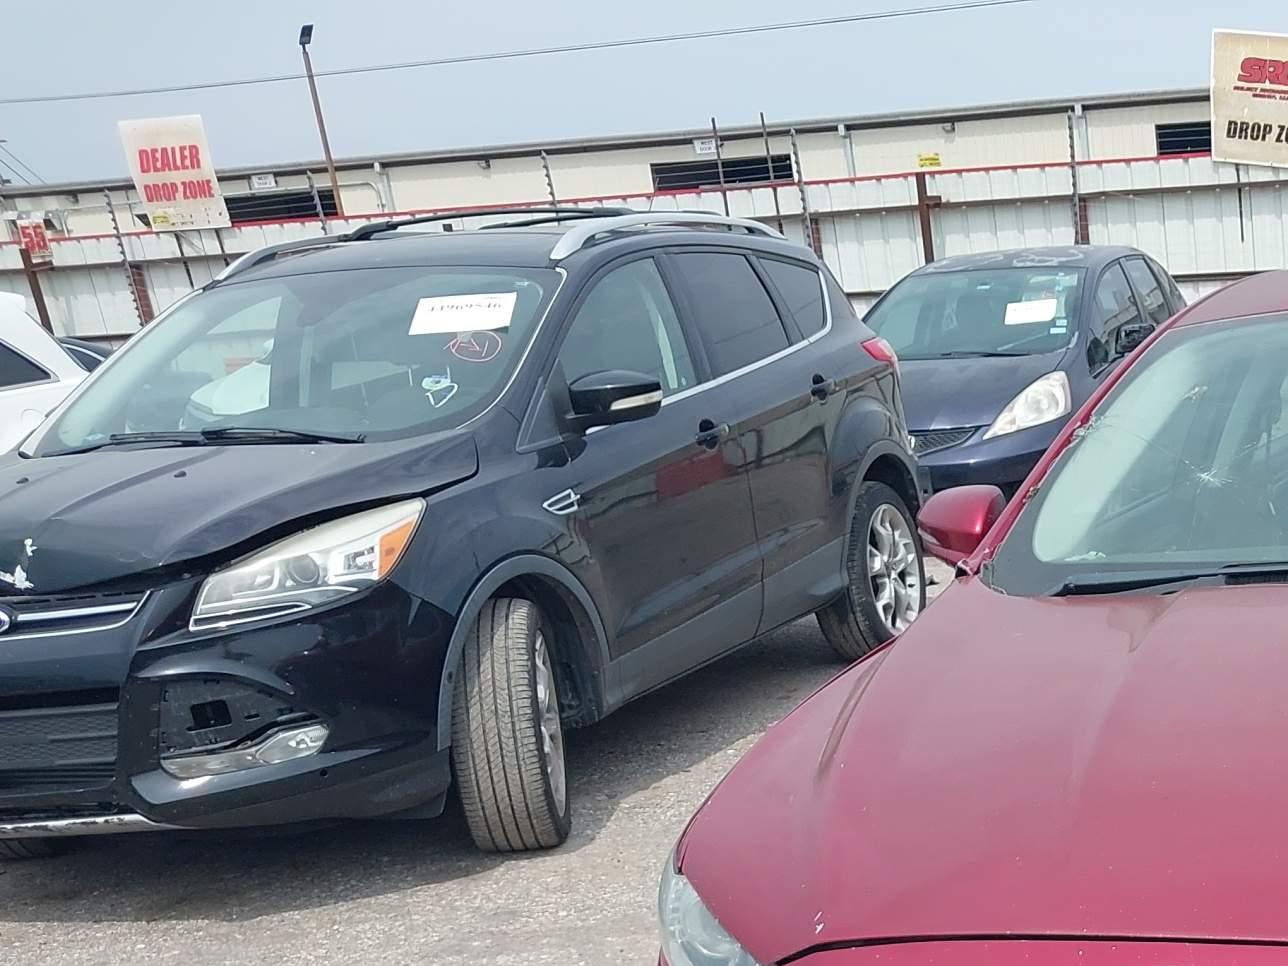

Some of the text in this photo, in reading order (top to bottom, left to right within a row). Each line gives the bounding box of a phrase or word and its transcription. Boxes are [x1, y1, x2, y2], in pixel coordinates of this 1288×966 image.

[1226, 120, 1273, 142] DROP
[138, 144, 201, 174] DEALER
[143, 179, 215, 203] DROP ZONE
